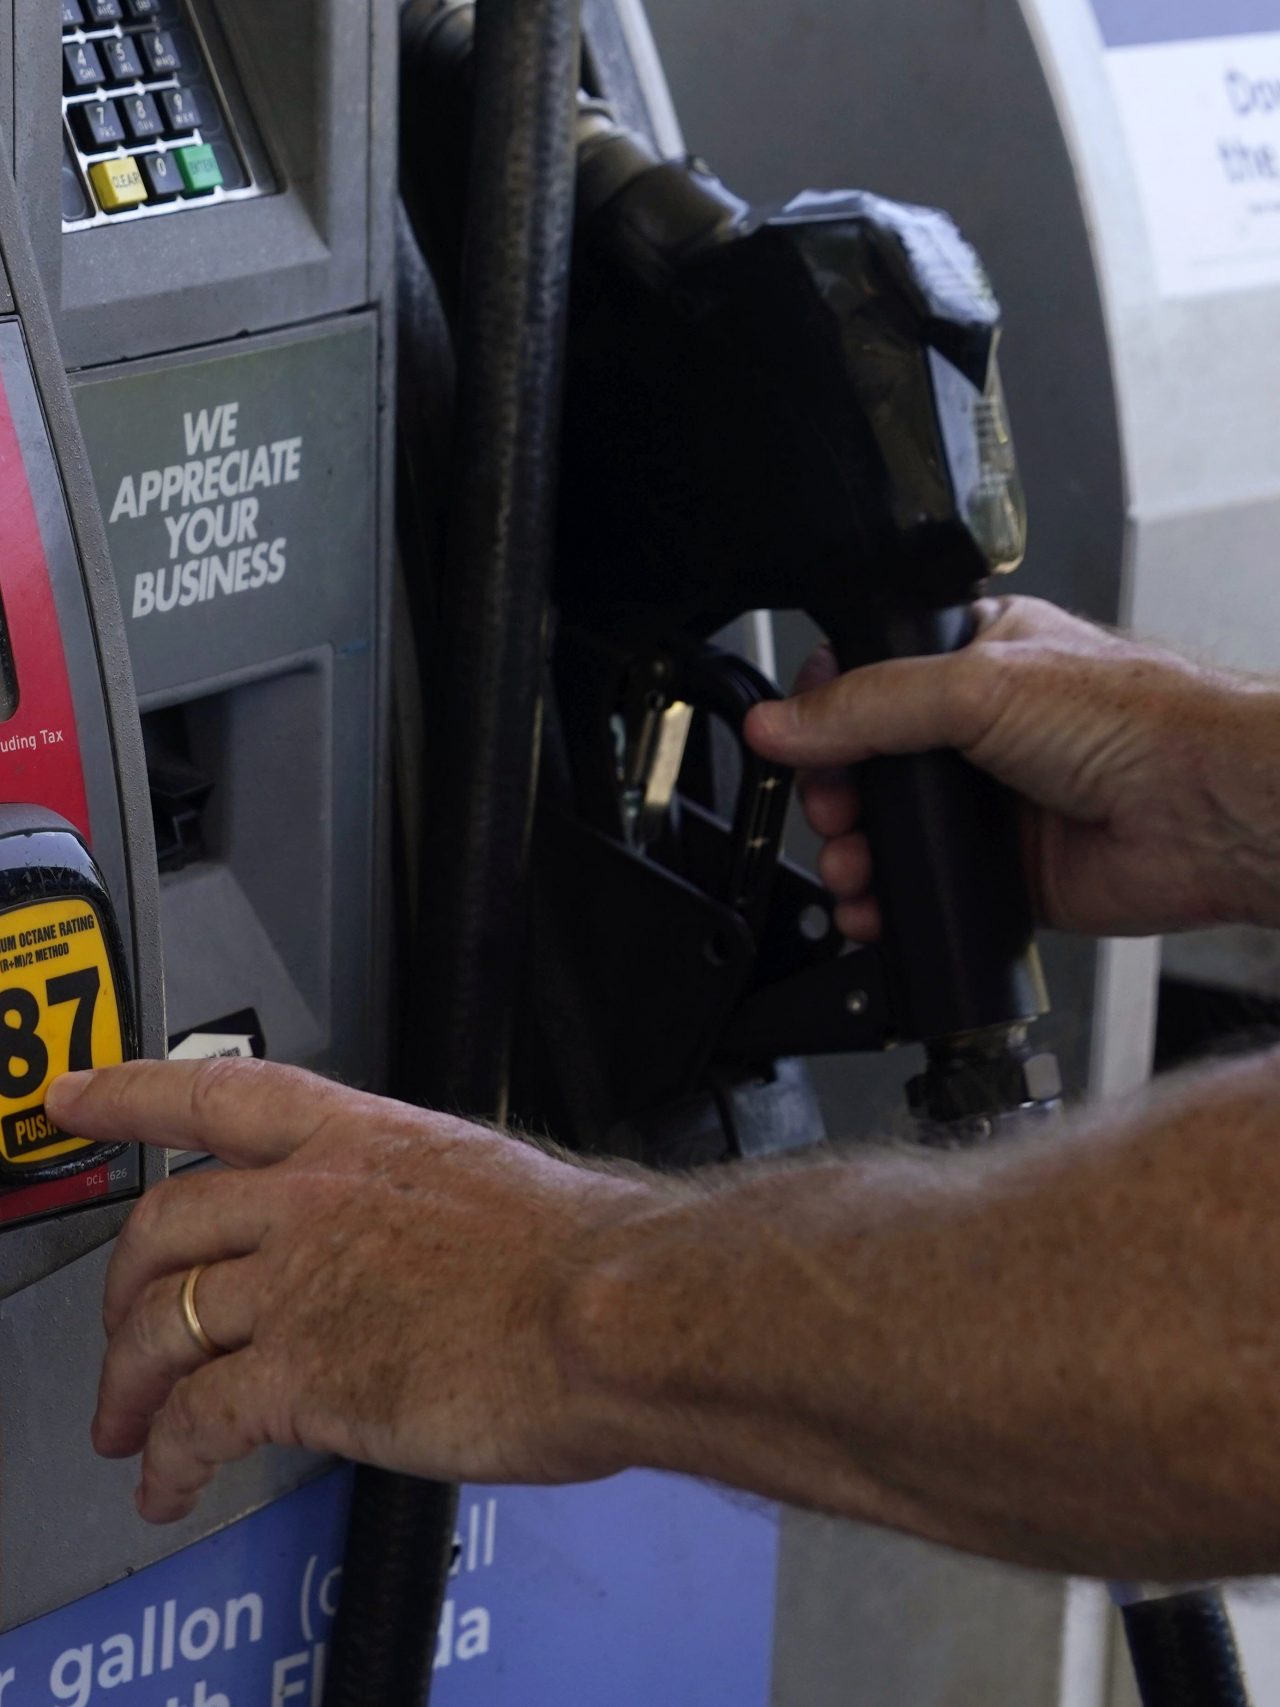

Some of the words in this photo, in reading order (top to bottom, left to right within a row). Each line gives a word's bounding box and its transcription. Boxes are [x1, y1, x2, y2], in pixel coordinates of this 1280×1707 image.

[116, 43, 125, 61] 5
[154, 37, 163, 54] 6
[77, 48, 87, 66] 4
[136, 100, 146, 119] 8
[174, 93, 183, 112] 9
[96, 106, 105, 125] 7
[157, 157, 167, 177] 0
[112, 171, 140, 188] CLEAR
[183, 402, 239, 456] WE
[109, 436, 302, 524] APPRECIATE
[164, 497, 259, 559] YOUR
[132, 537, 287, 619] BUSINESS
[39, 729, 64, 744] Tax
[19, 924, 57, 948] OCTANE
[59, 914, 95, 938] RATING
[35, 941, 69, 962] METHOD
[50, 1591, 264, 1707] gallon
